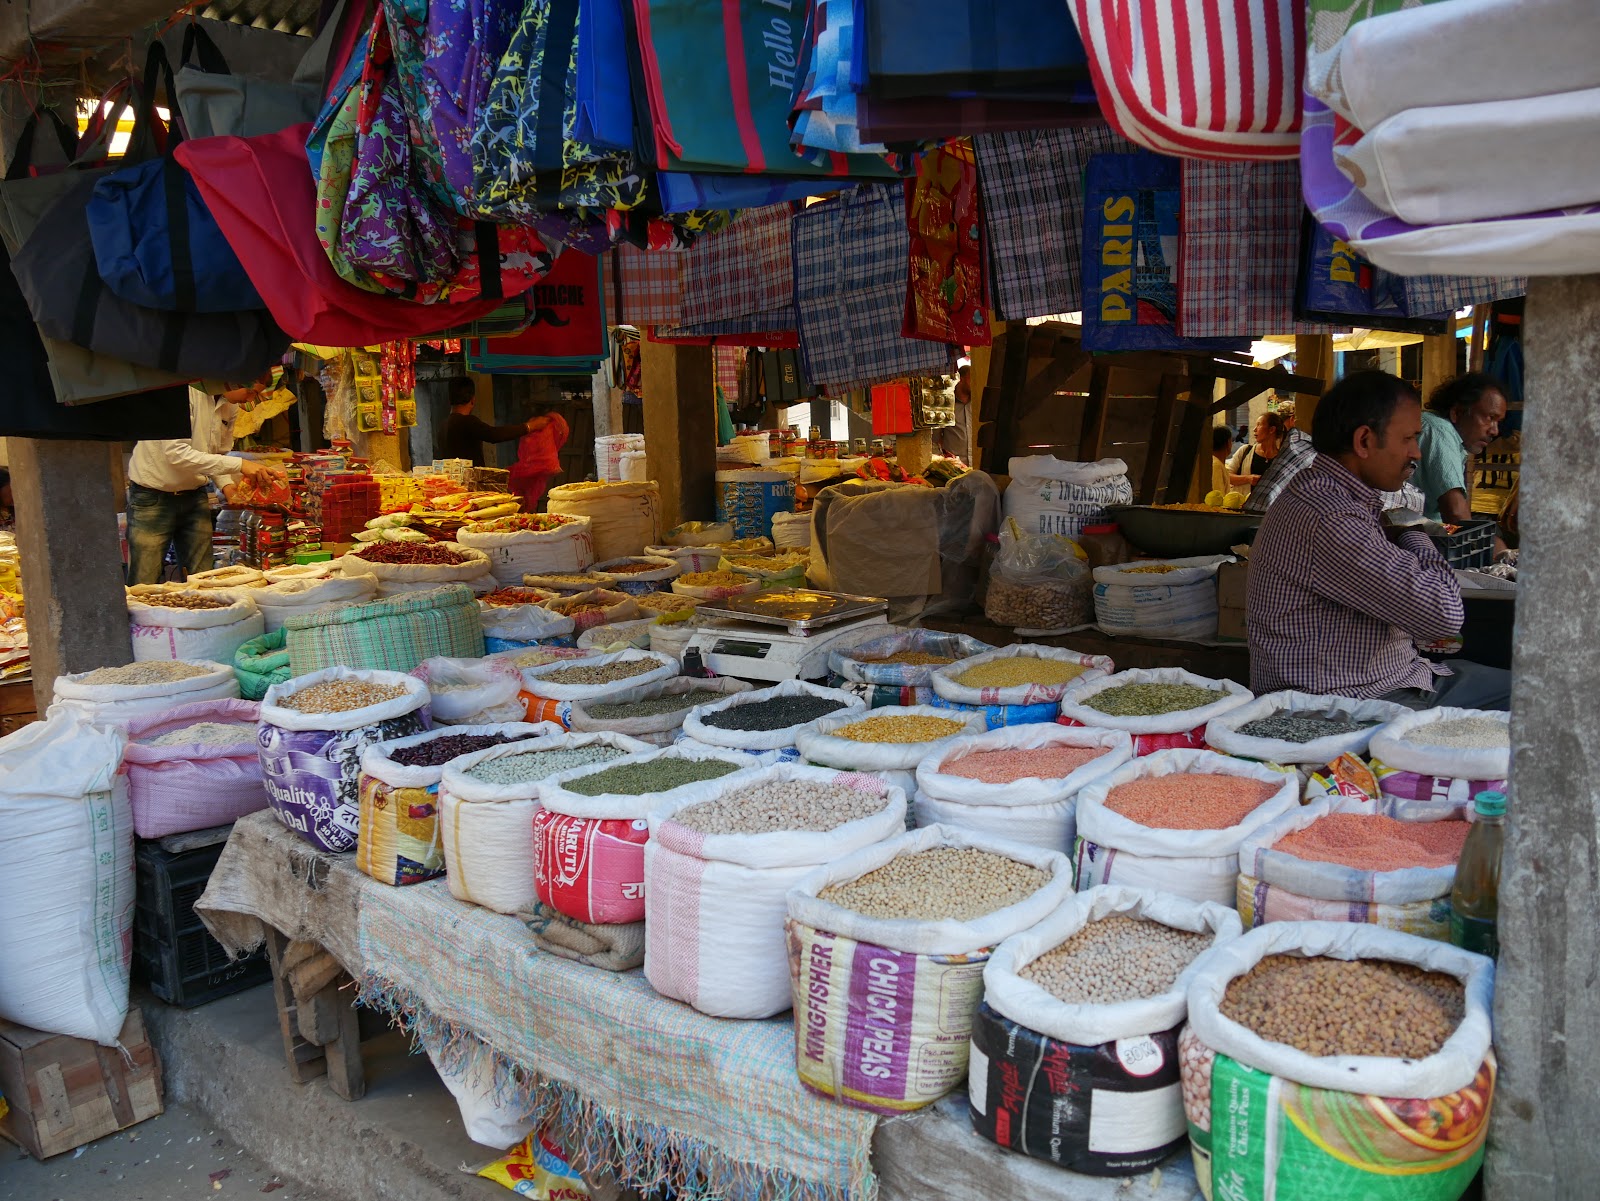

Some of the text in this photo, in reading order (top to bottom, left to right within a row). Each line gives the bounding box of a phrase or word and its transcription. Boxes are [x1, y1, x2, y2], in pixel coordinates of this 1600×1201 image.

[763, 18, 796, 89] Hello
[1102, 195, 1135, 322] PARIS
[533, 284, 585, 306] STACHE
[268, 779, 316, 809] Quality
[284, 810, 309, 833] Dal
[320, 825, 331, 836] 30
[560, 825, 569, 854] BRAND
[805, 943, 833, 1063] KINGFISHER
[860, 957, 900, 1080] CHICK PEAS
[1227, 1077, 1241, 1159] Premium Quality
[1237, 1086, 1250, 1156] Chick Peas
[1049, 1137, 1062, 1161] Qualit
